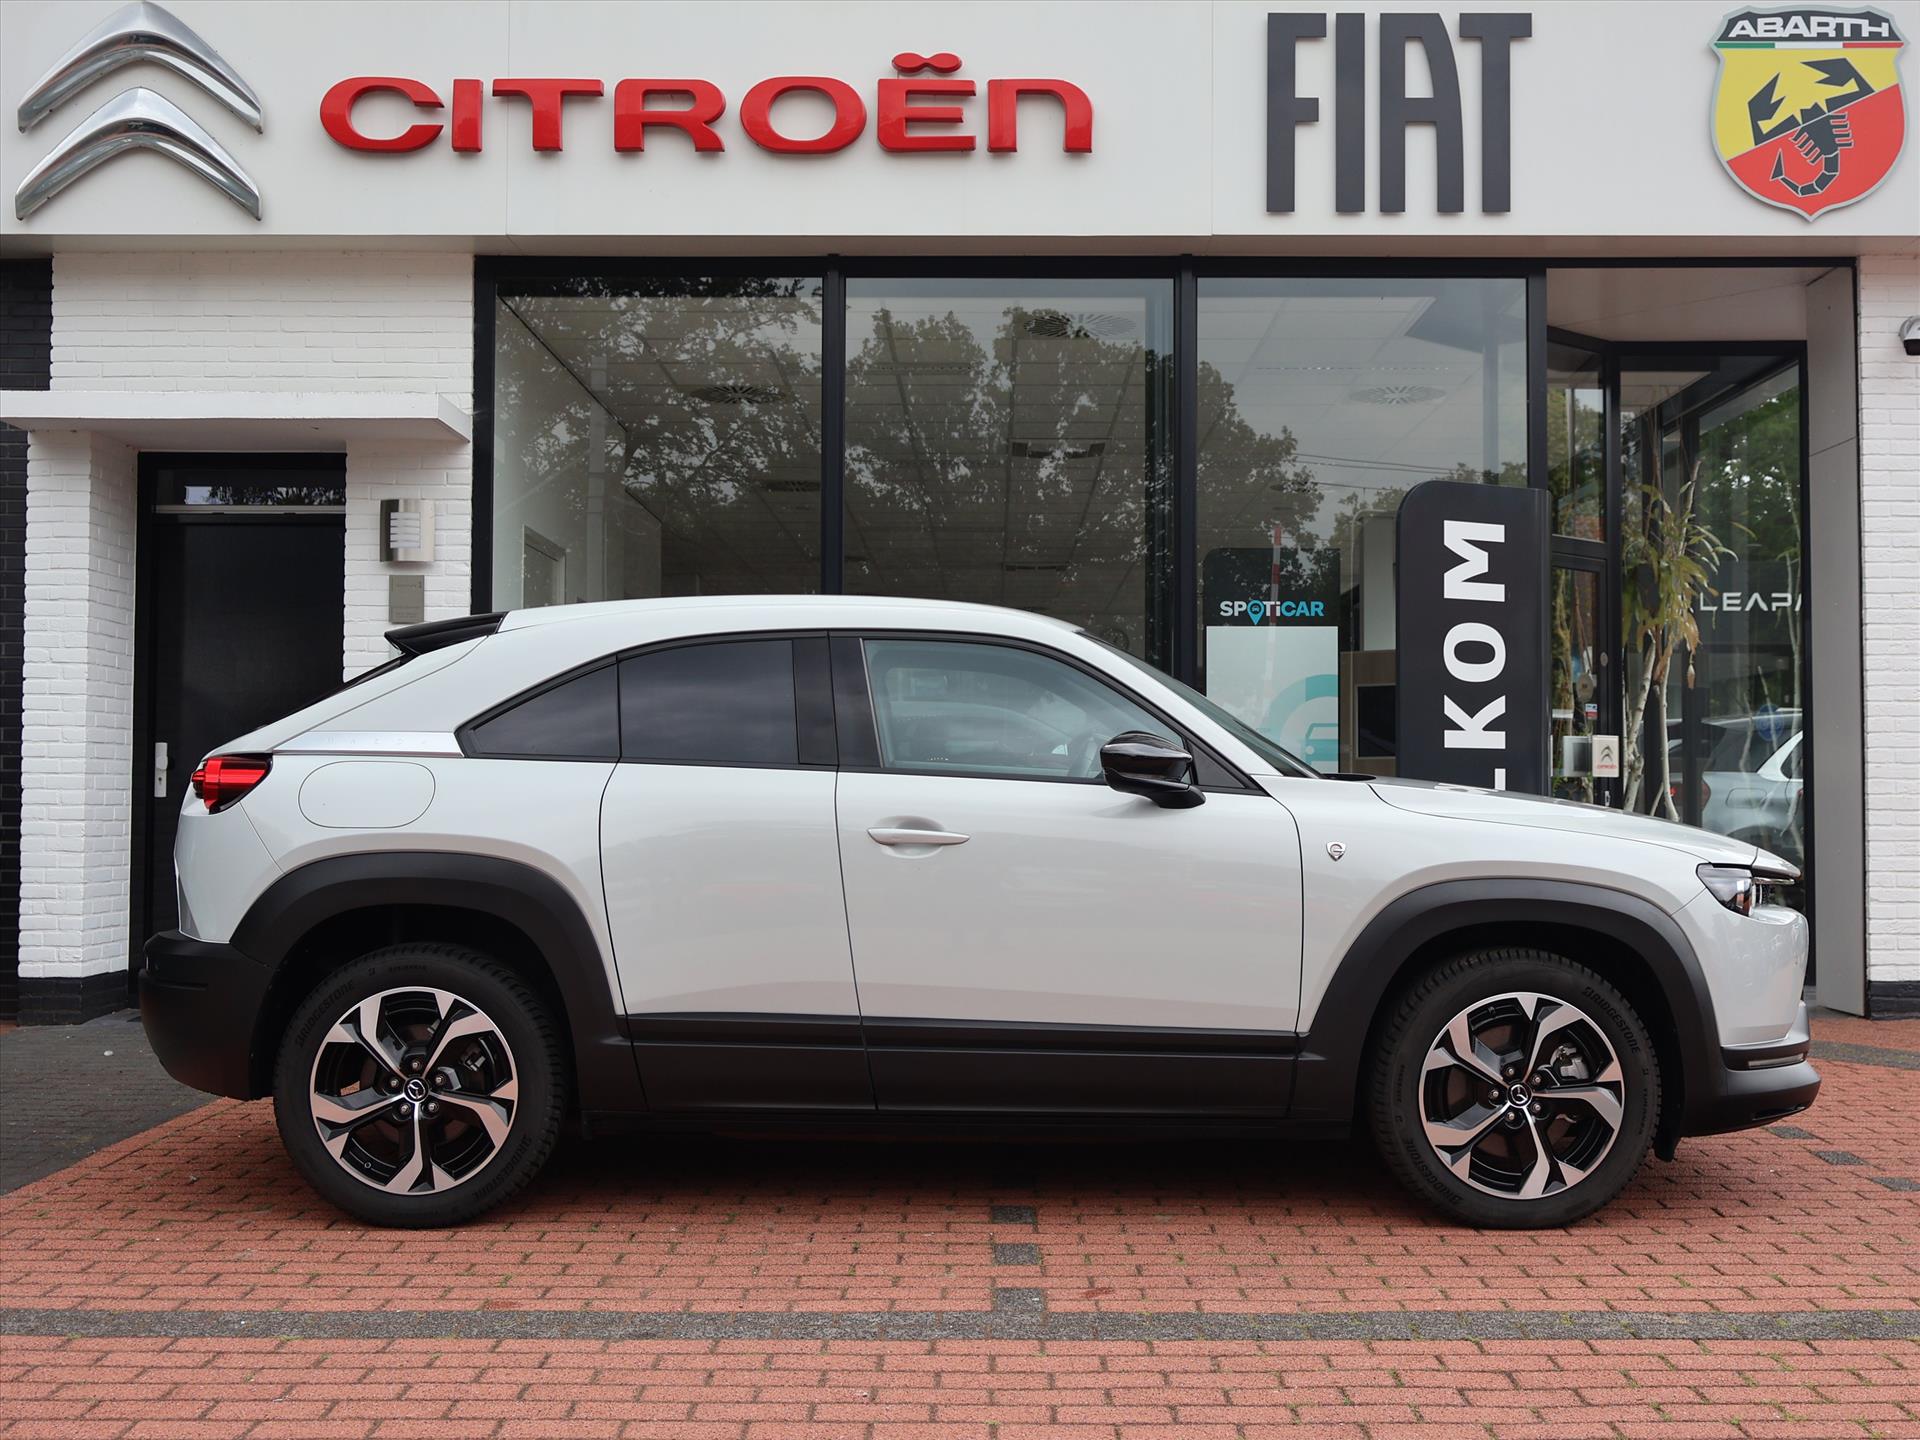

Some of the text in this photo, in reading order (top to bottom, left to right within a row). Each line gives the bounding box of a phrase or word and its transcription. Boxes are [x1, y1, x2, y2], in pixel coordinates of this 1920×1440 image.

[1728, 17, 1890, 38] ABARTH
[321, 52, 1094, 153] CITROËN
[1267, 13, 1532, 213] FIAT
[1581, 986, 1641, 1053] BRIDGESTONE
